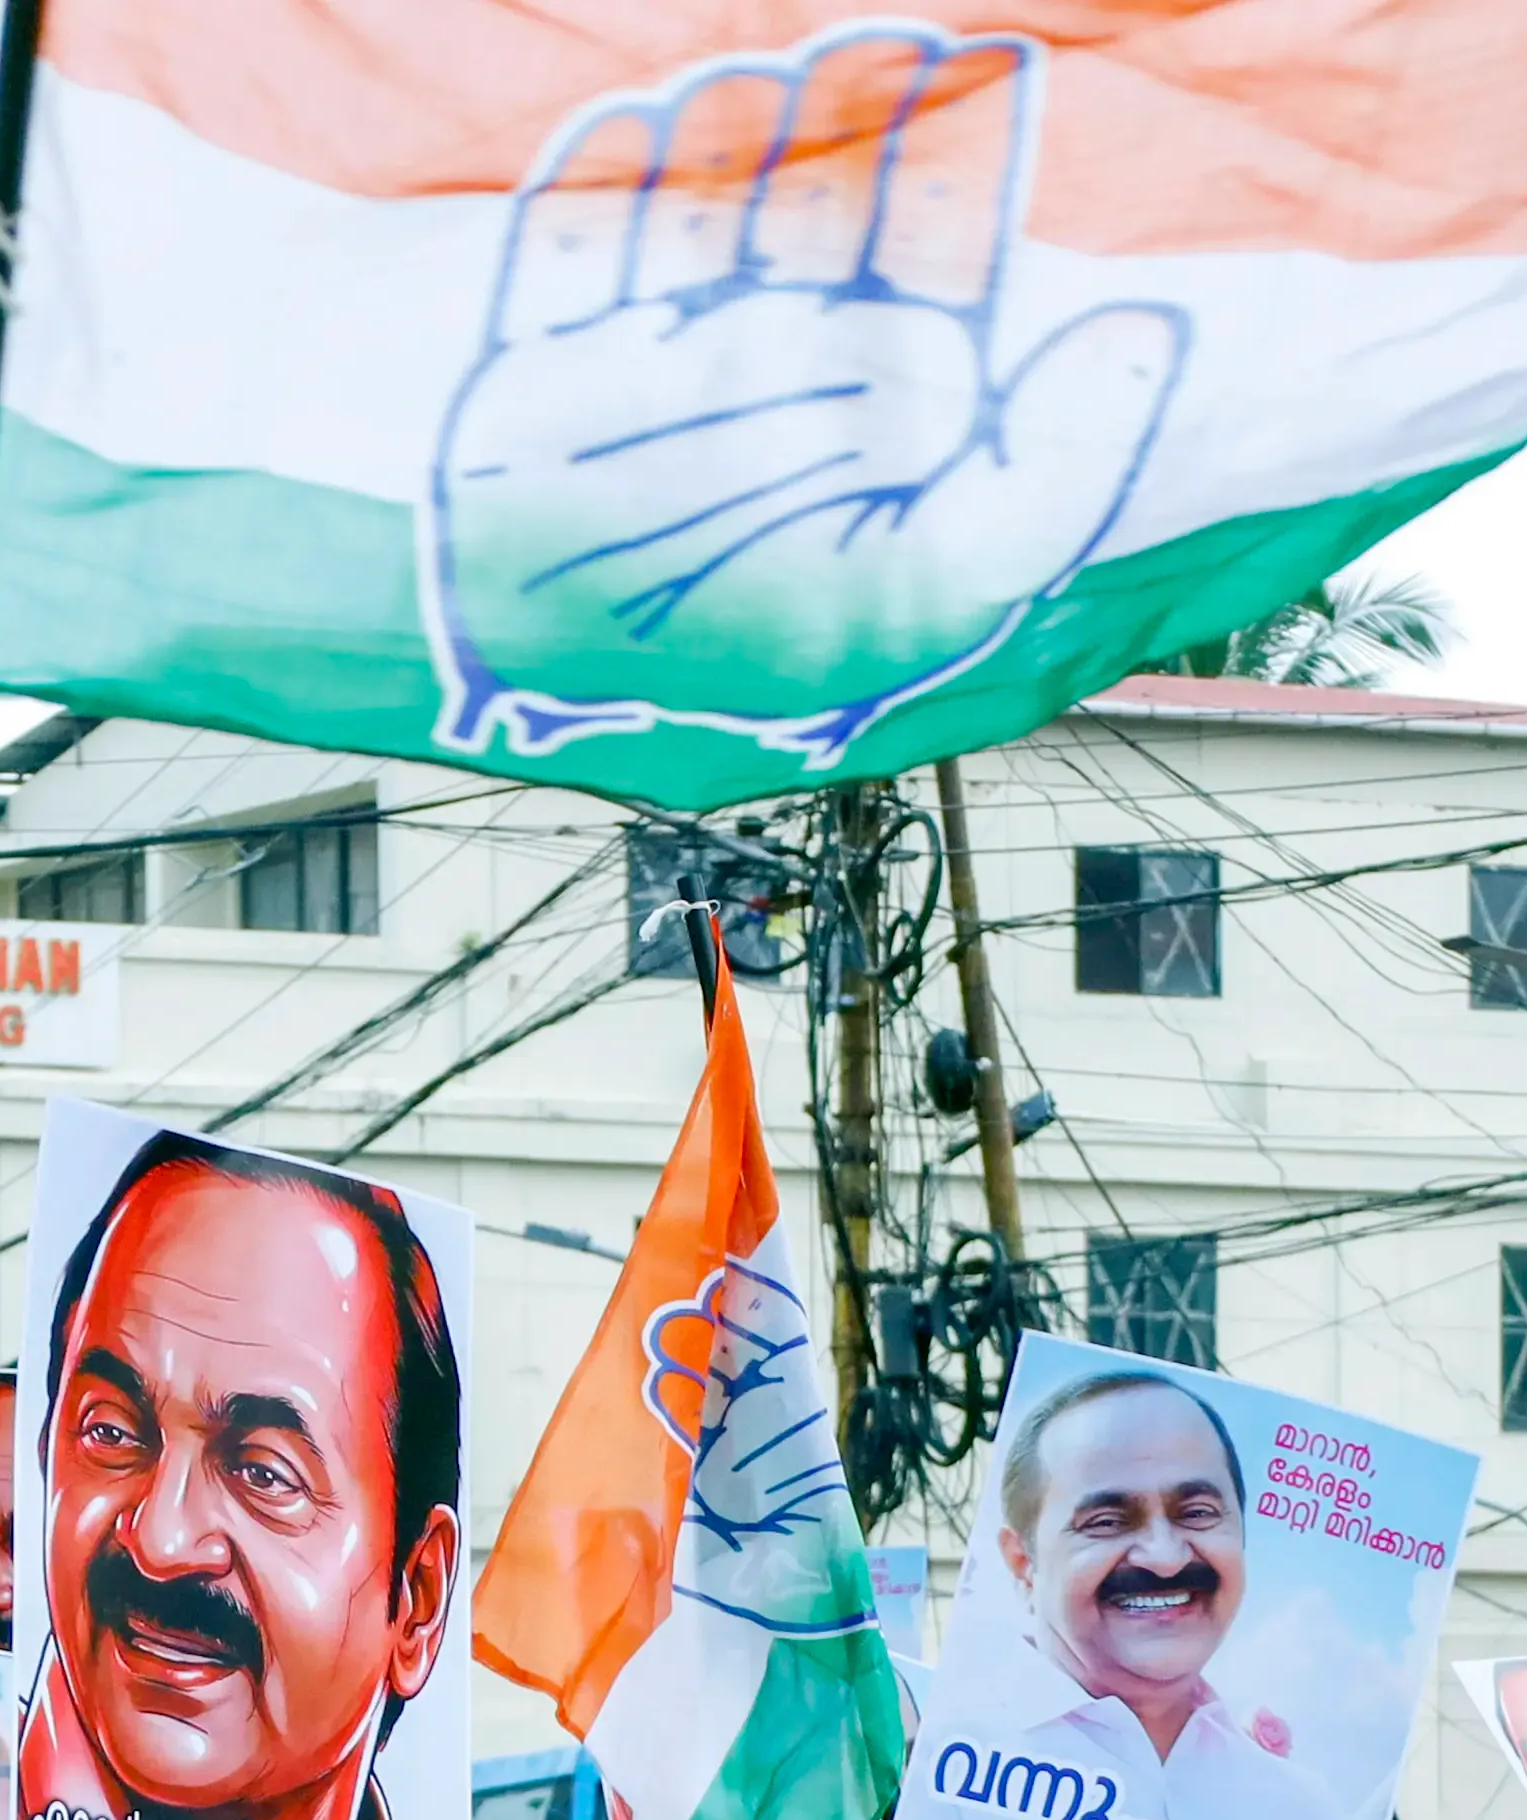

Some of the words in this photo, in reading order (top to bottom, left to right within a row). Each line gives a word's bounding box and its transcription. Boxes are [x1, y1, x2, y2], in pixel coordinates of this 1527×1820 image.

[1273, 1421, 1378, 1480] മാറാൻ,
[1264, 1455, 1373, 1511] കേരളം
[1257, 1490, 1318, 1535] മാറ്റി
[1323, 1508, 1447, 1571] മറിക്കാൻ
